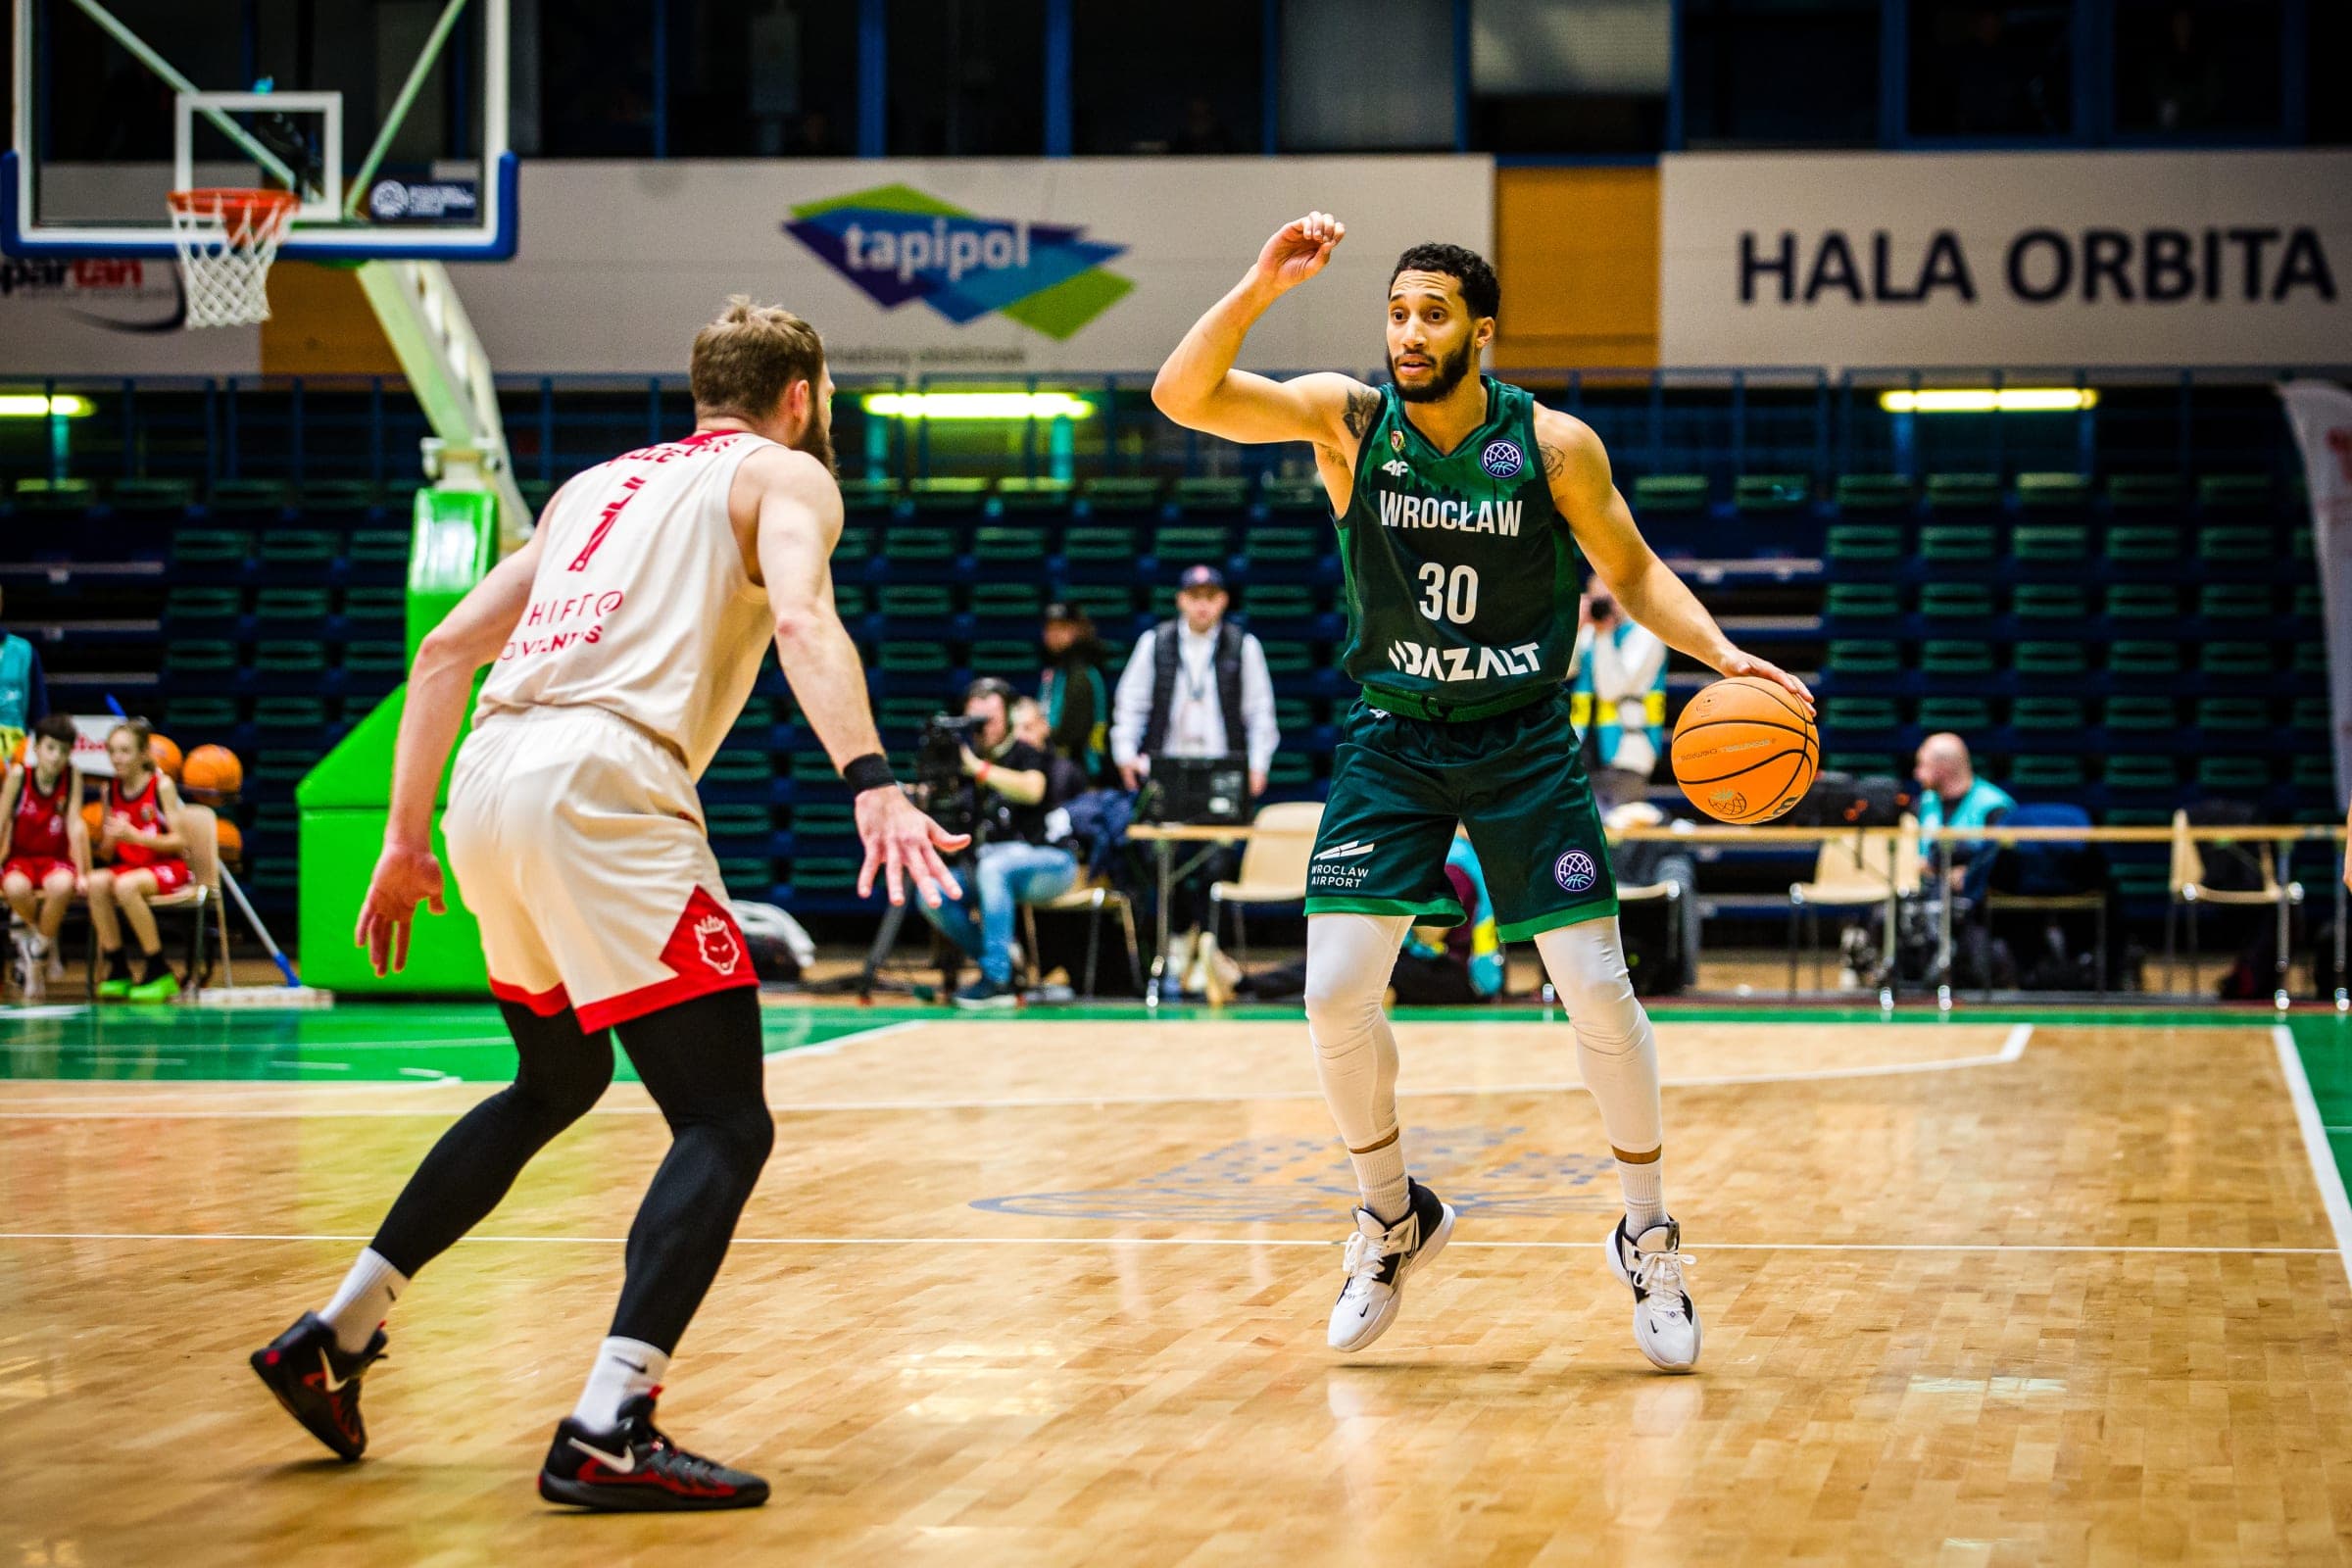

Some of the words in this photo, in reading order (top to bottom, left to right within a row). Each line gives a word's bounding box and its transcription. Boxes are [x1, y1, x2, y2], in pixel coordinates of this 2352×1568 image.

[844, 220, 1031, 281] tapipol
[1739, 230, 1977, 304] HALA
[2004, 224, 2340, 304] ORBITA
[1380, 490, 1523, 537] WROCŁAW
[1418, 562, 1479, 624] 30
[1311, 863, 1370, 879] WROCLAW
[1311, 875, 1363, 889] AIRPORT
